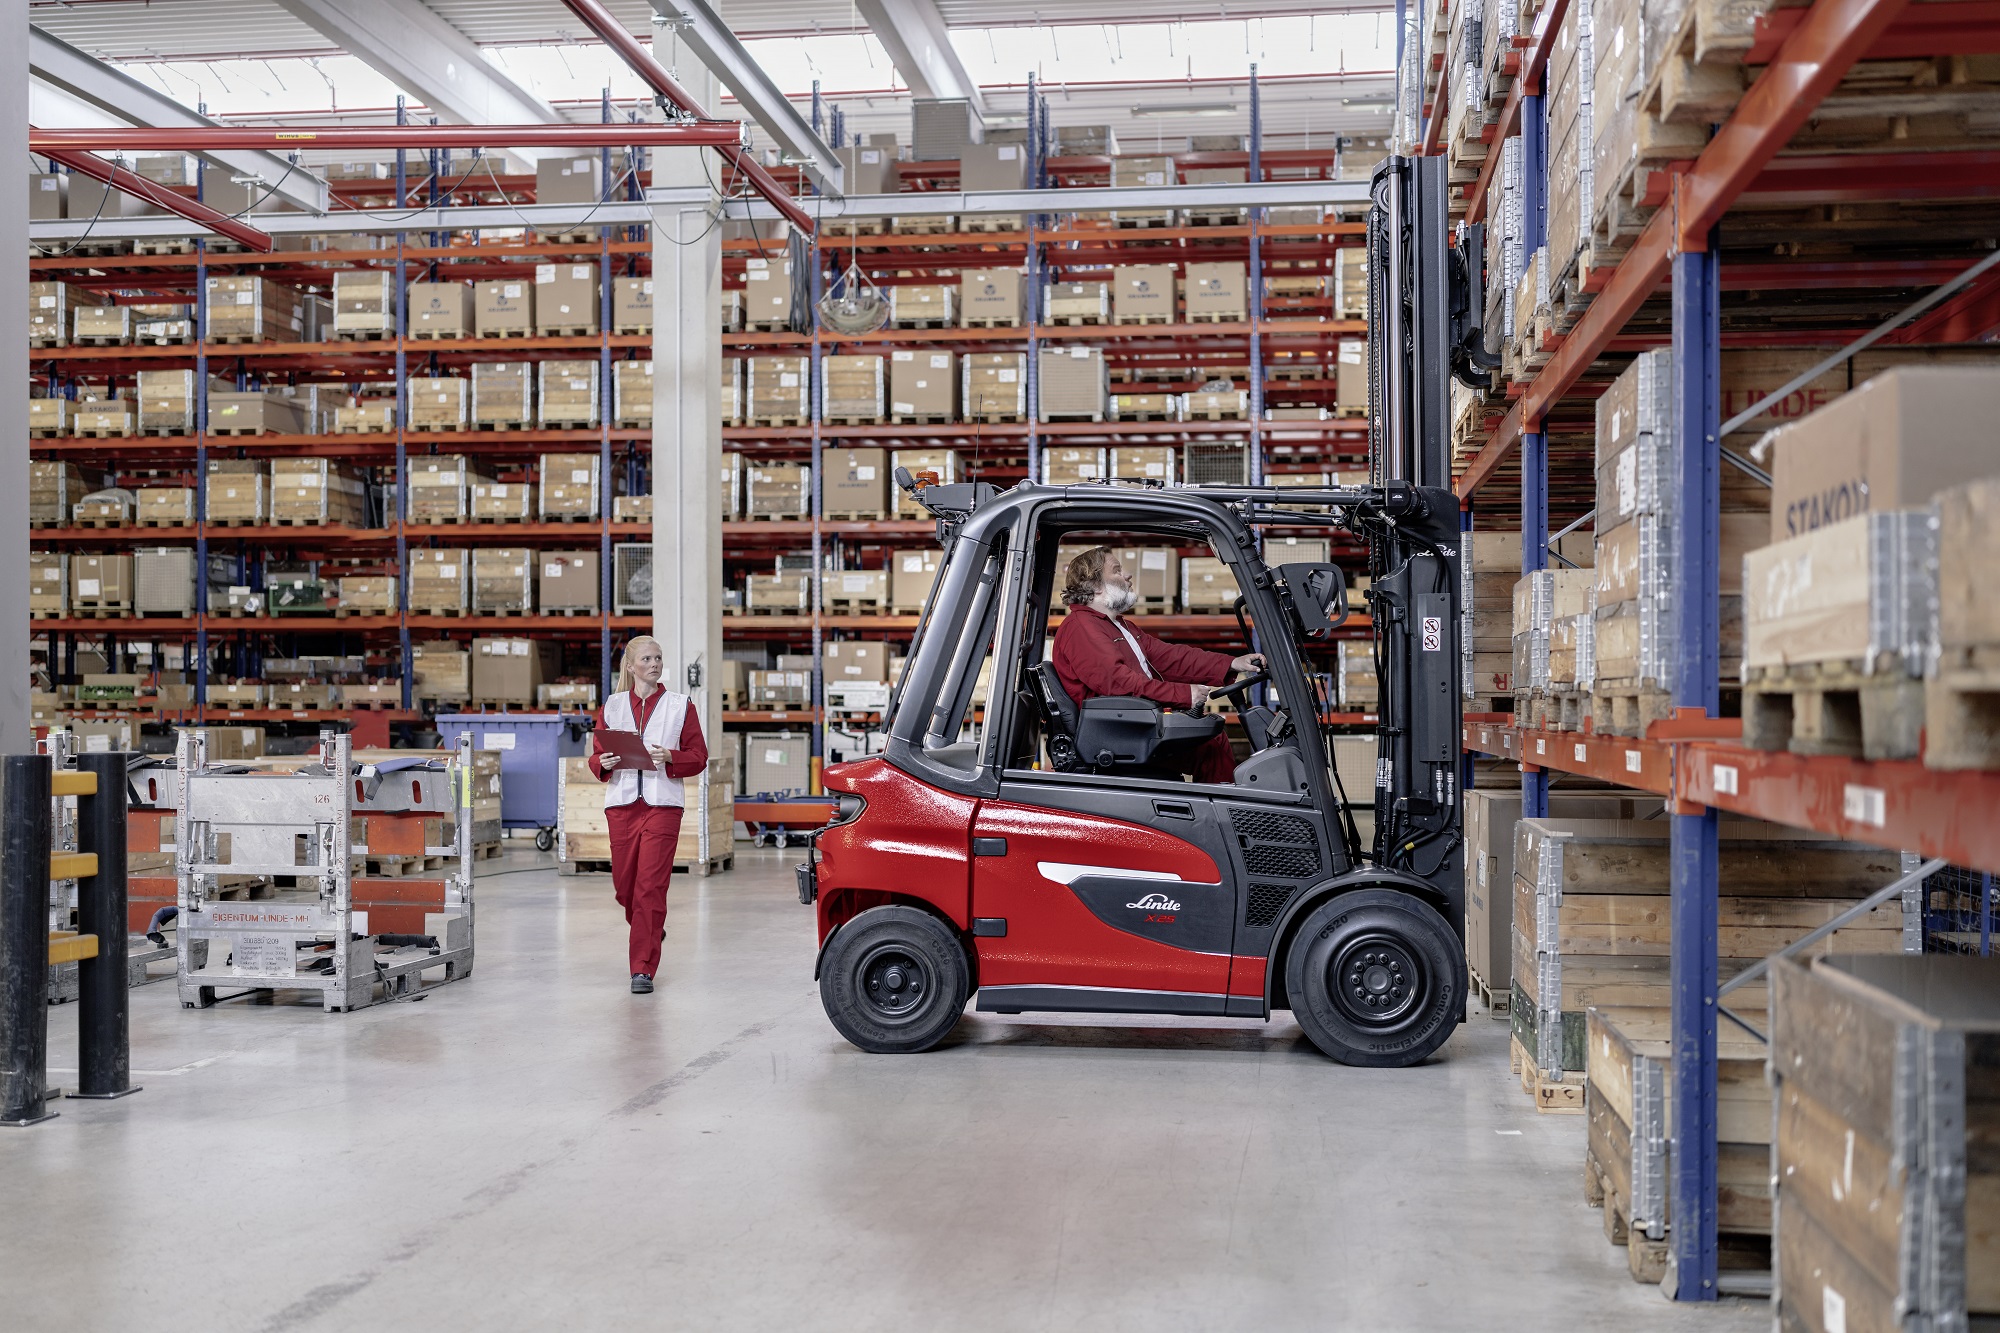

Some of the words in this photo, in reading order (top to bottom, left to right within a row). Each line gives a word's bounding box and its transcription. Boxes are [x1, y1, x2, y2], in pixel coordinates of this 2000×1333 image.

[314, 794, 330, 803] 126
[1125, 893, 1181, 911] Linde
[212, 913, 259, 922] EIGENTUM
[1319, 914, 1349, 941] CS20
[1368, 984, 1451, 1052] ContiSuperElastic
